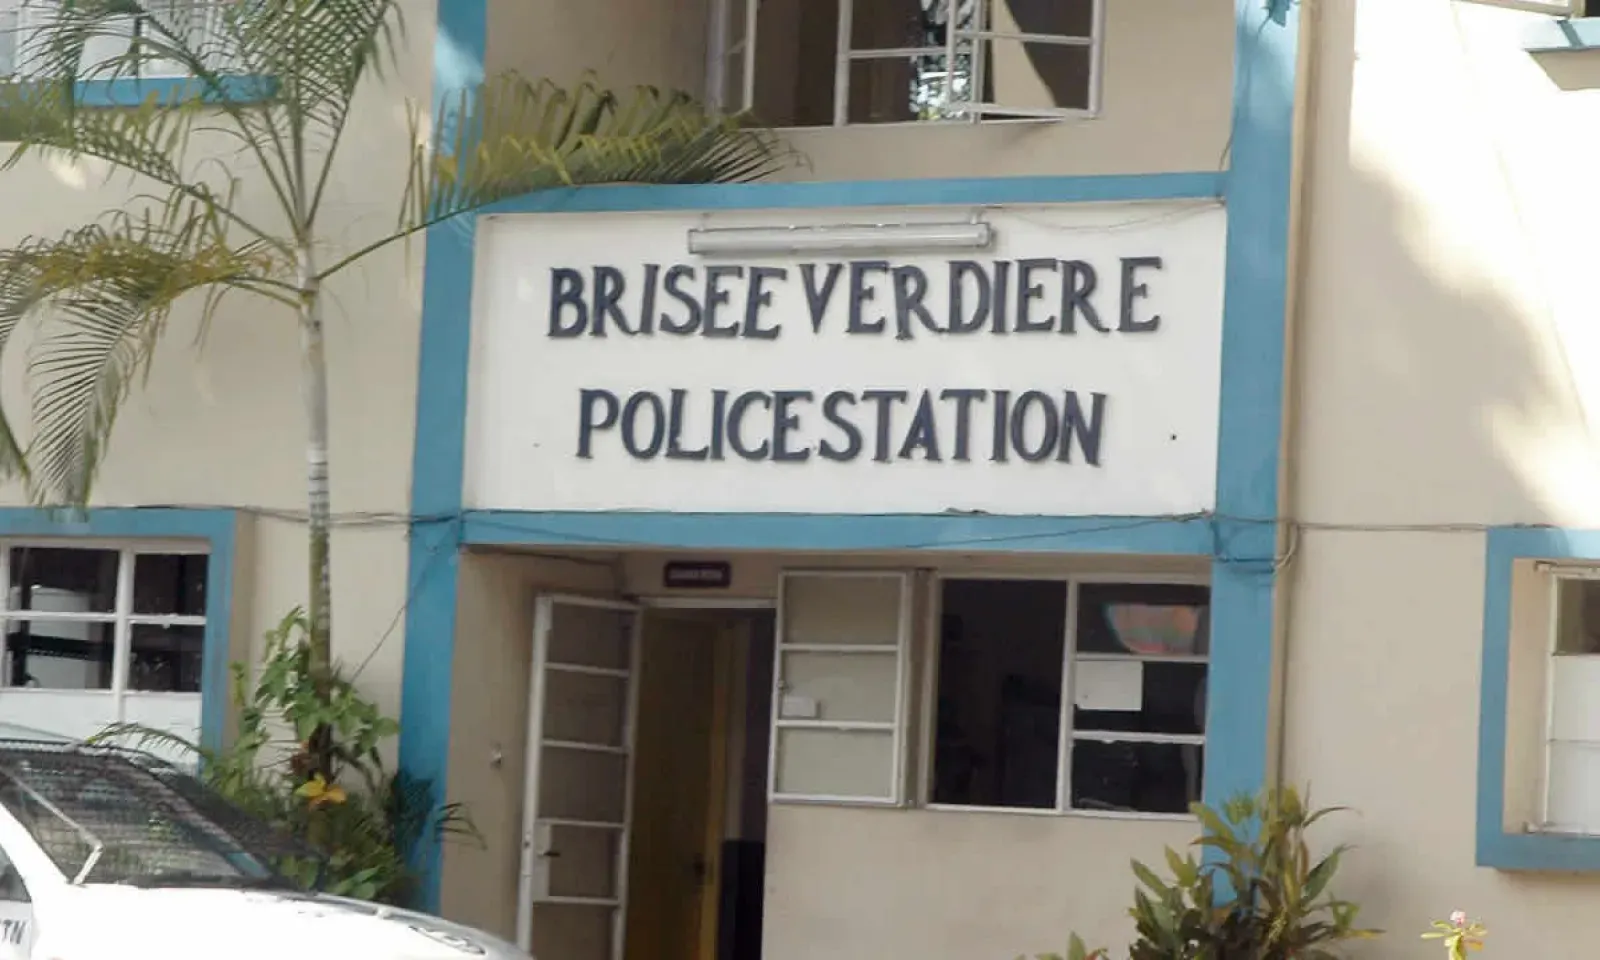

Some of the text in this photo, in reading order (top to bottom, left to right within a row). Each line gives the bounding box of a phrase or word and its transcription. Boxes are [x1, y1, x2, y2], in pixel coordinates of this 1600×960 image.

[547, 256, 1163, 341] BRISEE VERDIERE
[575, 388, 1107, 467] POLICE STATION
